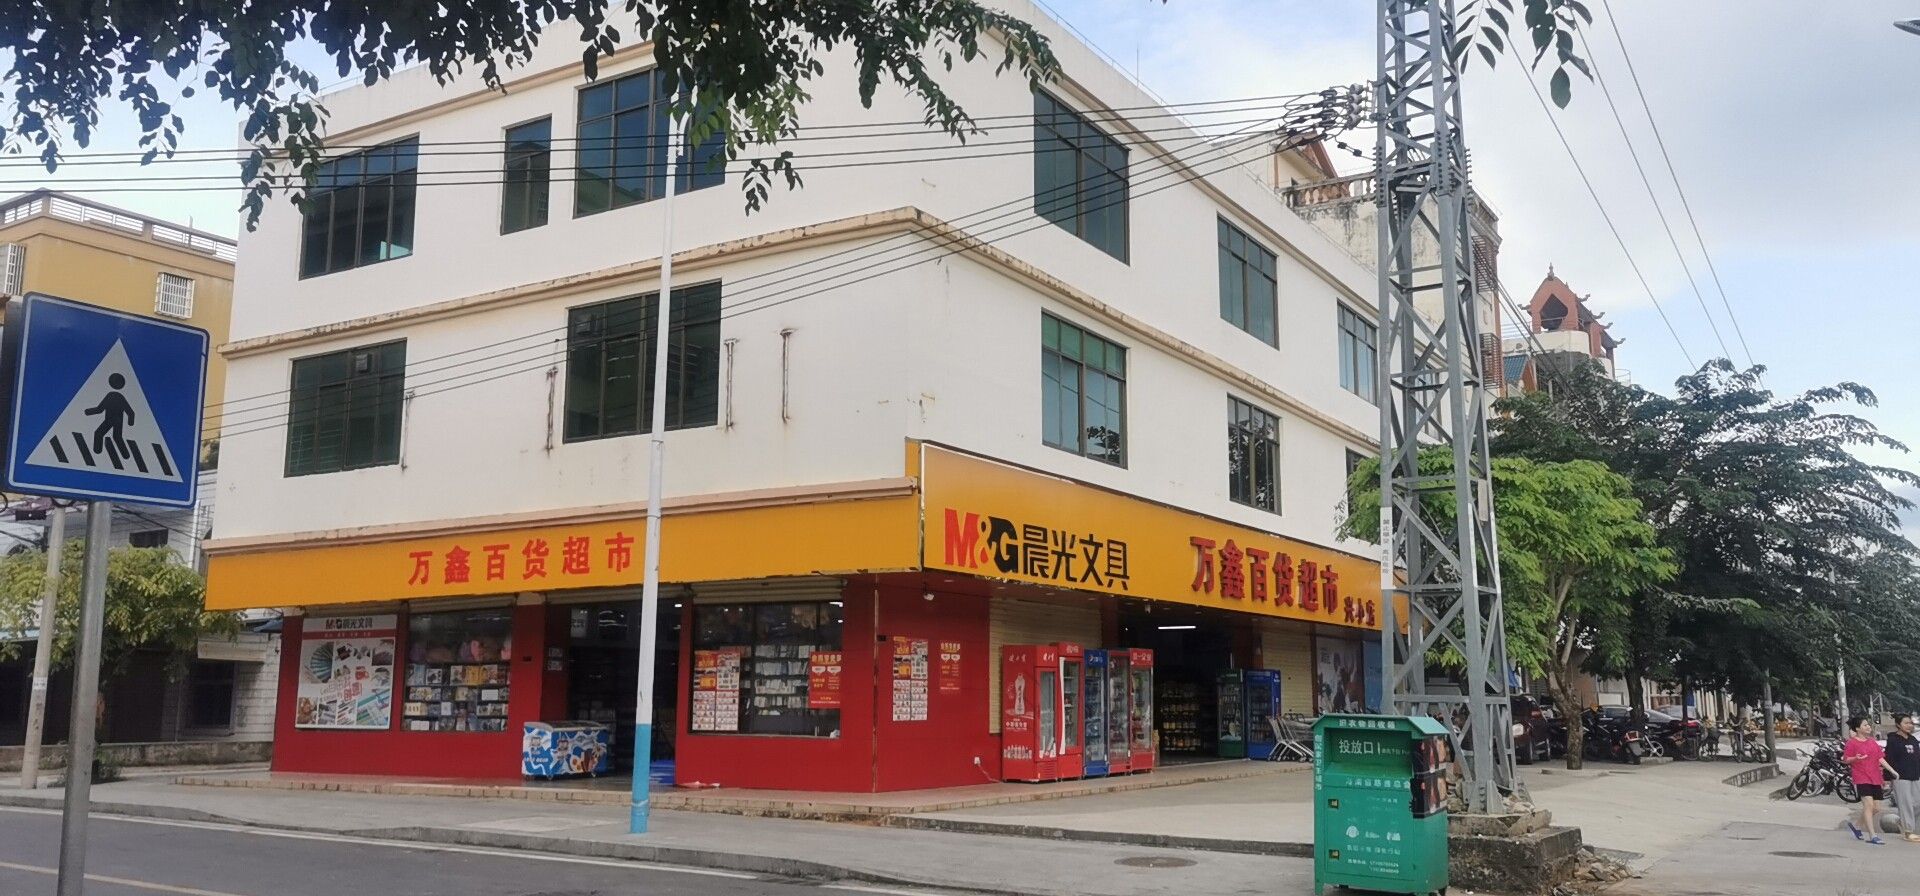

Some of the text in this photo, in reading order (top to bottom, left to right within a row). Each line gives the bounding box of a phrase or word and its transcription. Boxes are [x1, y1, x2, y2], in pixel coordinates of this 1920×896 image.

[408, 532, 635, 585] 万鑫百货超市
[944, 508, 1129, 590] M&G 晨光文具
[1190, 536, 1338, 614] 万鑫百货超市
[1344, 596, 1375, 626] 兴小店
[1339, 719, 1396, 729] 旧衣物回收箱
[1339, 740, 1374, 754] 投放口
